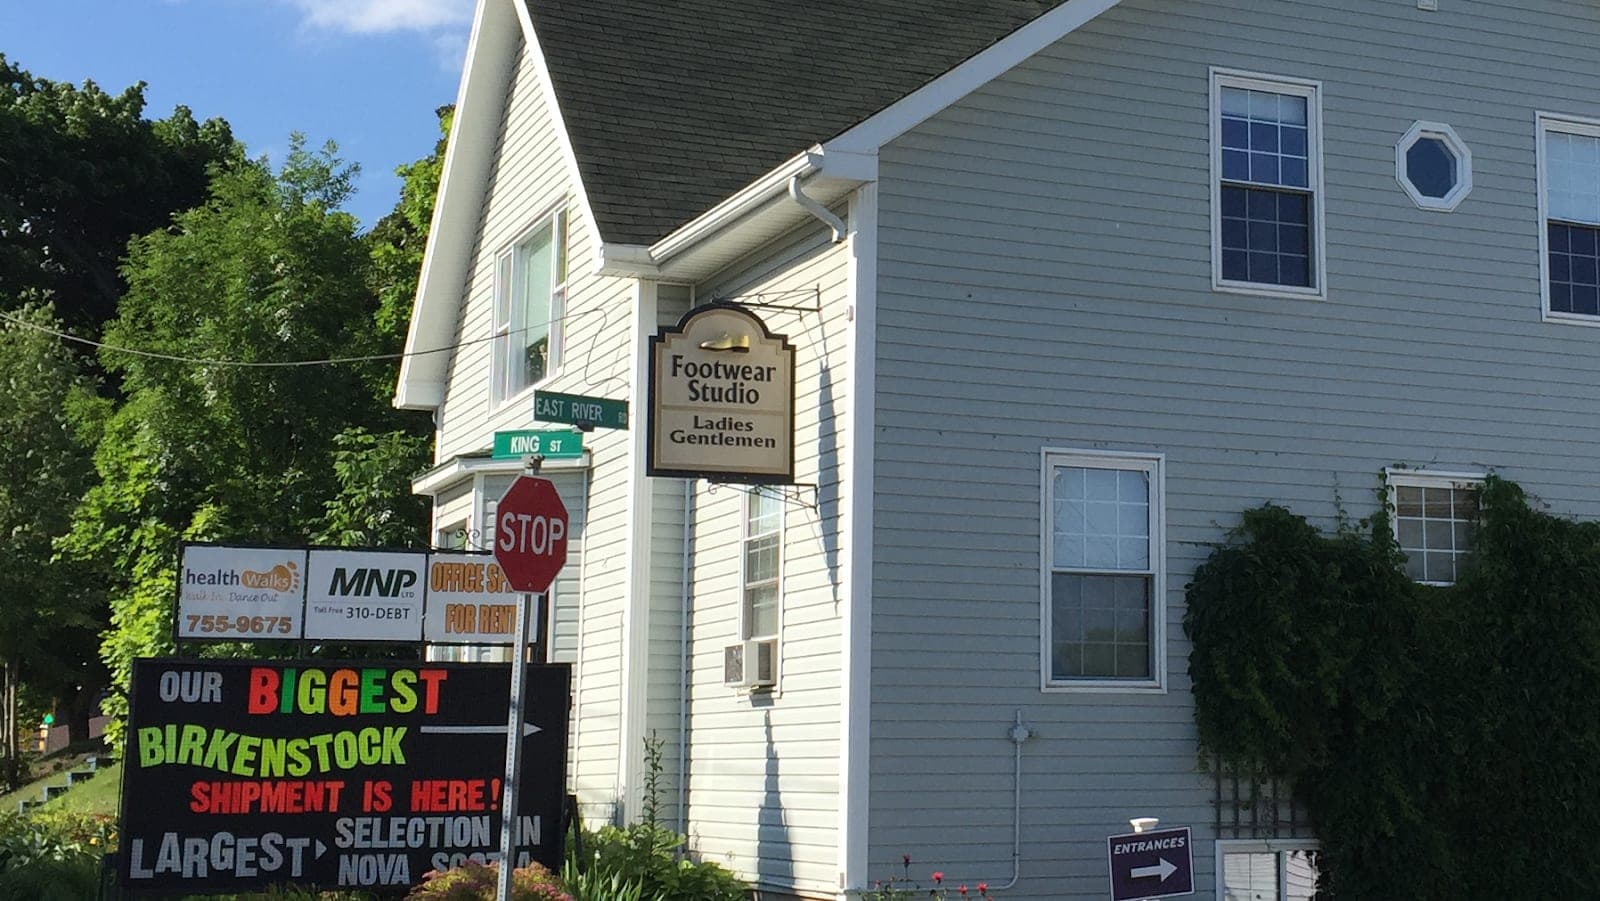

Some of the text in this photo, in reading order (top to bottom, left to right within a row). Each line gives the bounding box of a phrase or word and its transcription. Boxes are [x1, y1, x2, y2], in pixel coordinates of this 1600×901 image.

[671, 354, 777, 382] Footwear
[688, 379, 760, 404] Studio
[535, 397, 564, 417] EAST
[571, 402, 603, 421] RIVER
[693, 415, 754, 432] Ladies
[510, 435, 562, 454] KING ST
[669, 429, 776, 448] Gentlemen
[499, 511, 565, 556] STOP
[185, 568, 289, 588] health Walks
[328, 567, 417, 598] MNP
[431, 561, 484, 593] OFFICE
[186, 614, 292, 634] 755-9675
[346, 606, 410, 620] 310-DEBT
[445, 603, 517, 635] FOR RENT
[159, 667, 448, 717] OUR BIGGEST
[138, 724, 407, 778] BIRKENSTOCK
[189, 778, 501, 815] SHIPMENT IS HERE!
[334, 815, 541, 849] SELECTION IN
[1113, 837, 1185, 855] ENTRANCES
[129, 831, 310, 879] LARGEST
[338, 853, 410, 886] NOVA
